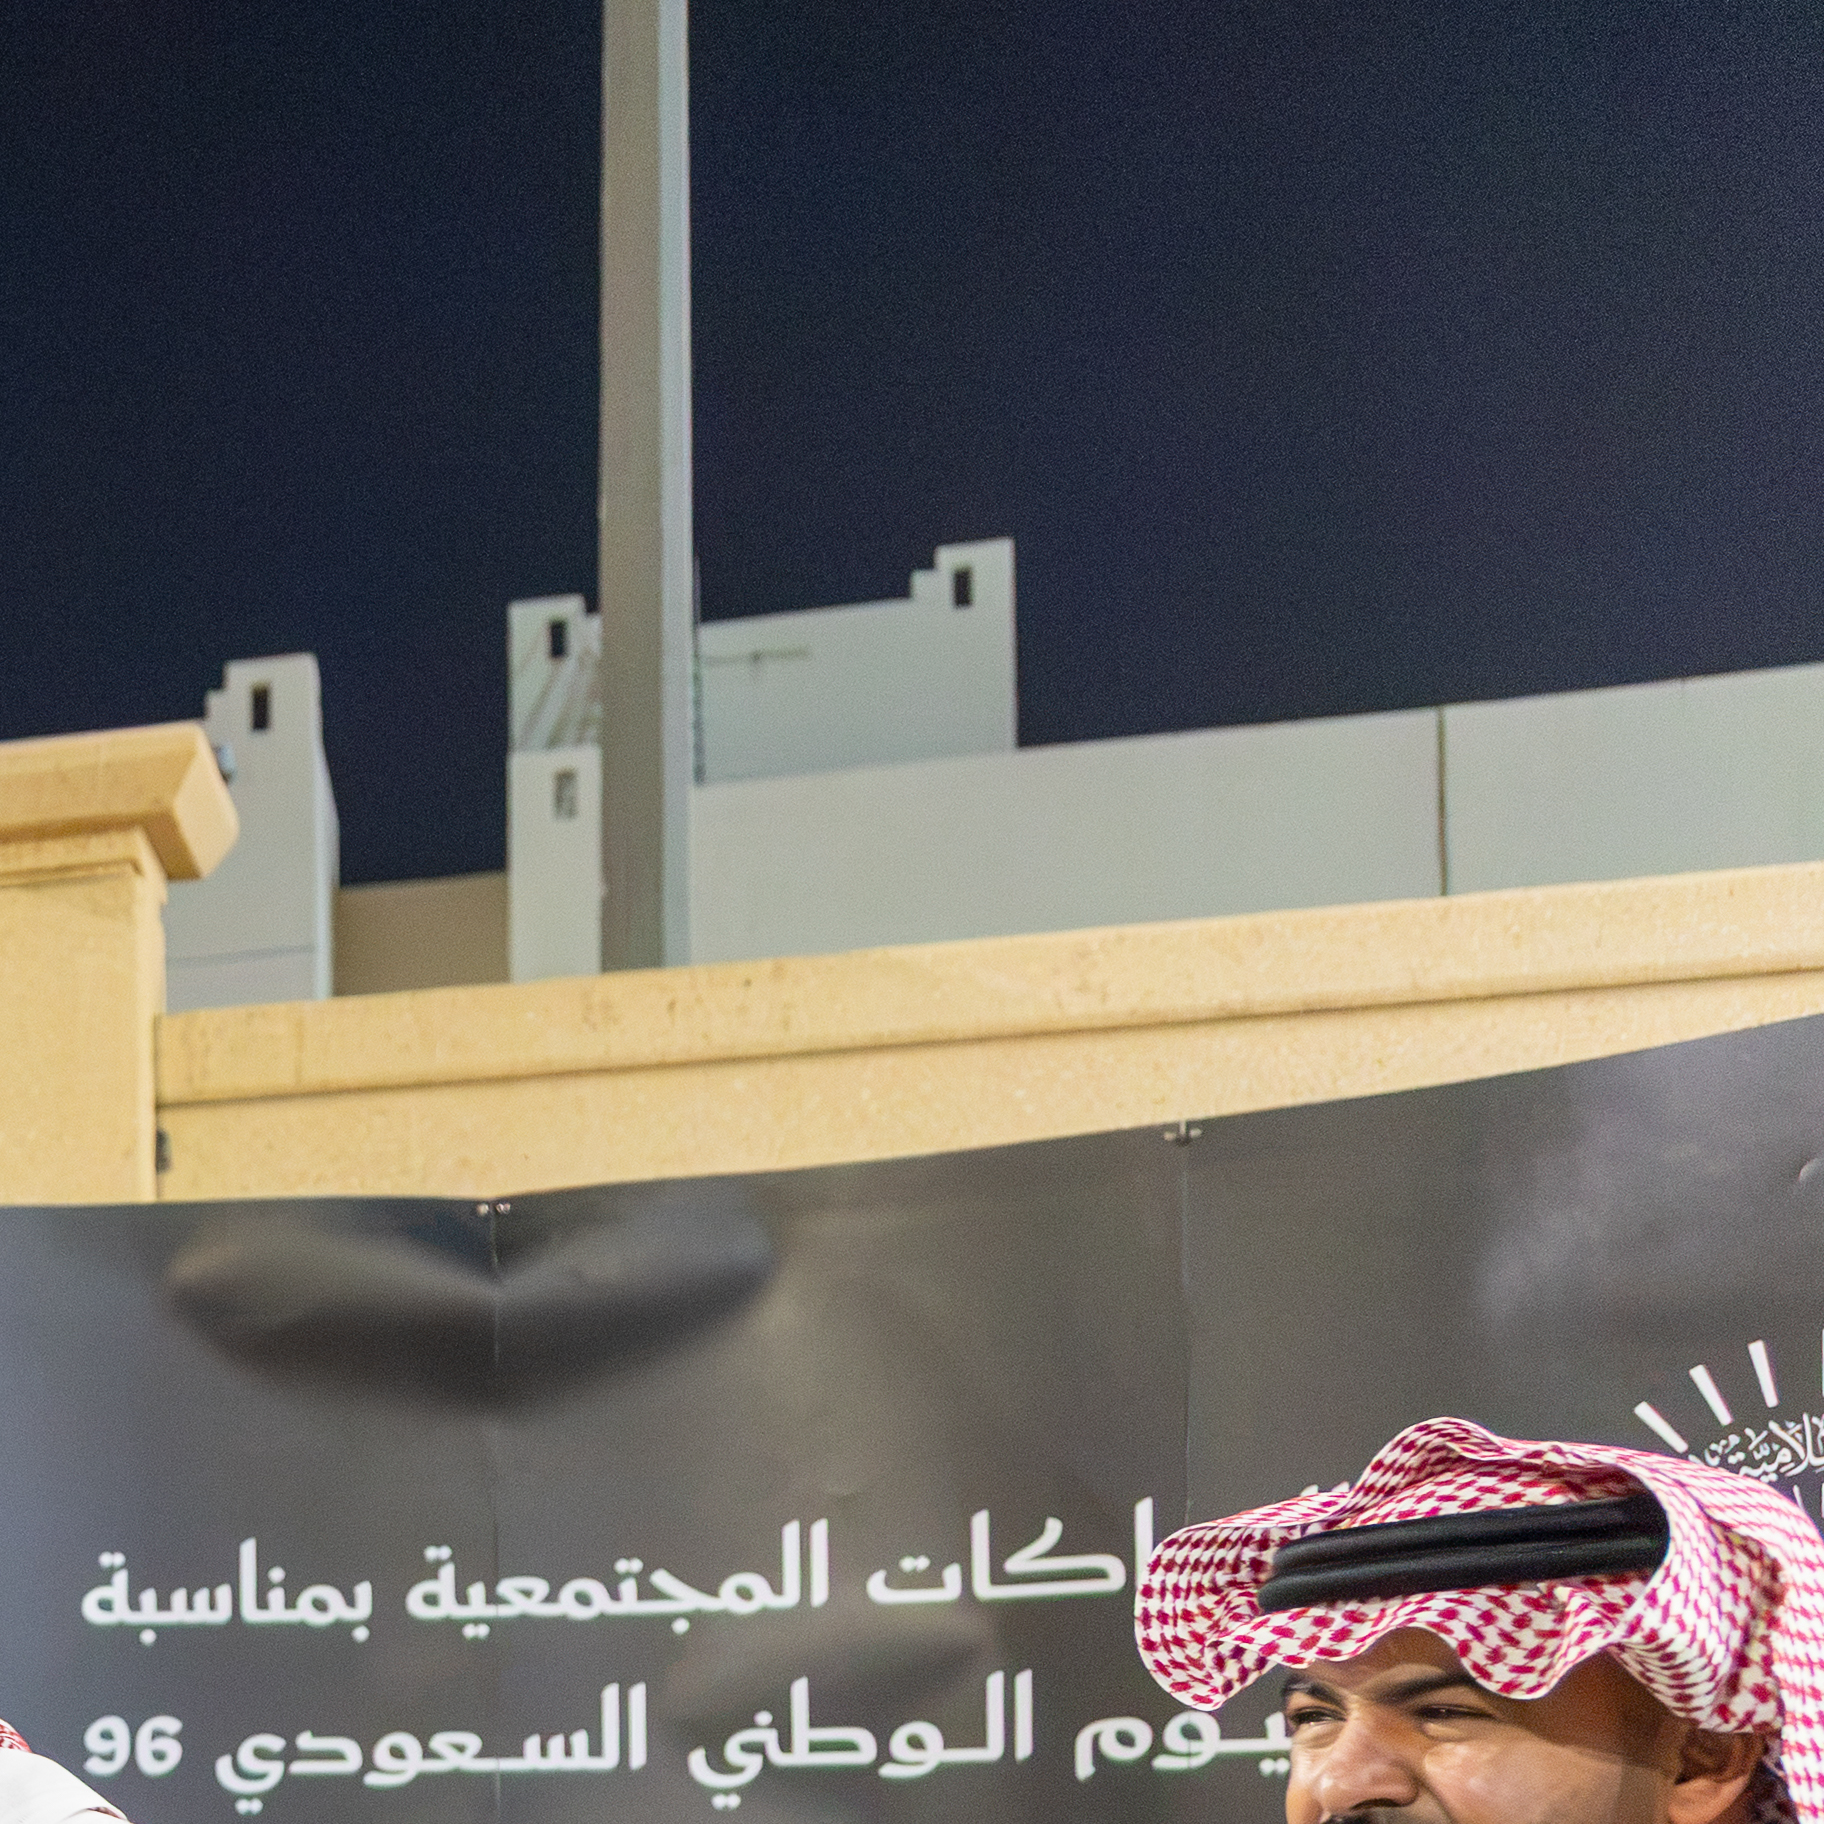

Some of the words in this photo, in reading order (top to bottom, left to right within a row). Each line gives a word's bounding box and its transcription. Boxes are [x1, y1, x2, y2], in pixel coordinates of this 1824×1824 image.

[81, 1537, 373, 1645] بمناسبة
[405, 1518, 829, 1639] المجتمعية
[866, 1496, 1153, 1600] اكات
[83, 1714, 184, 1777] 96
[215, 1682, 647, 1815] السعودي
[687, 1669, 1033, 1810] الوطني
[1074, 1710, 1292, 1781] يوم
